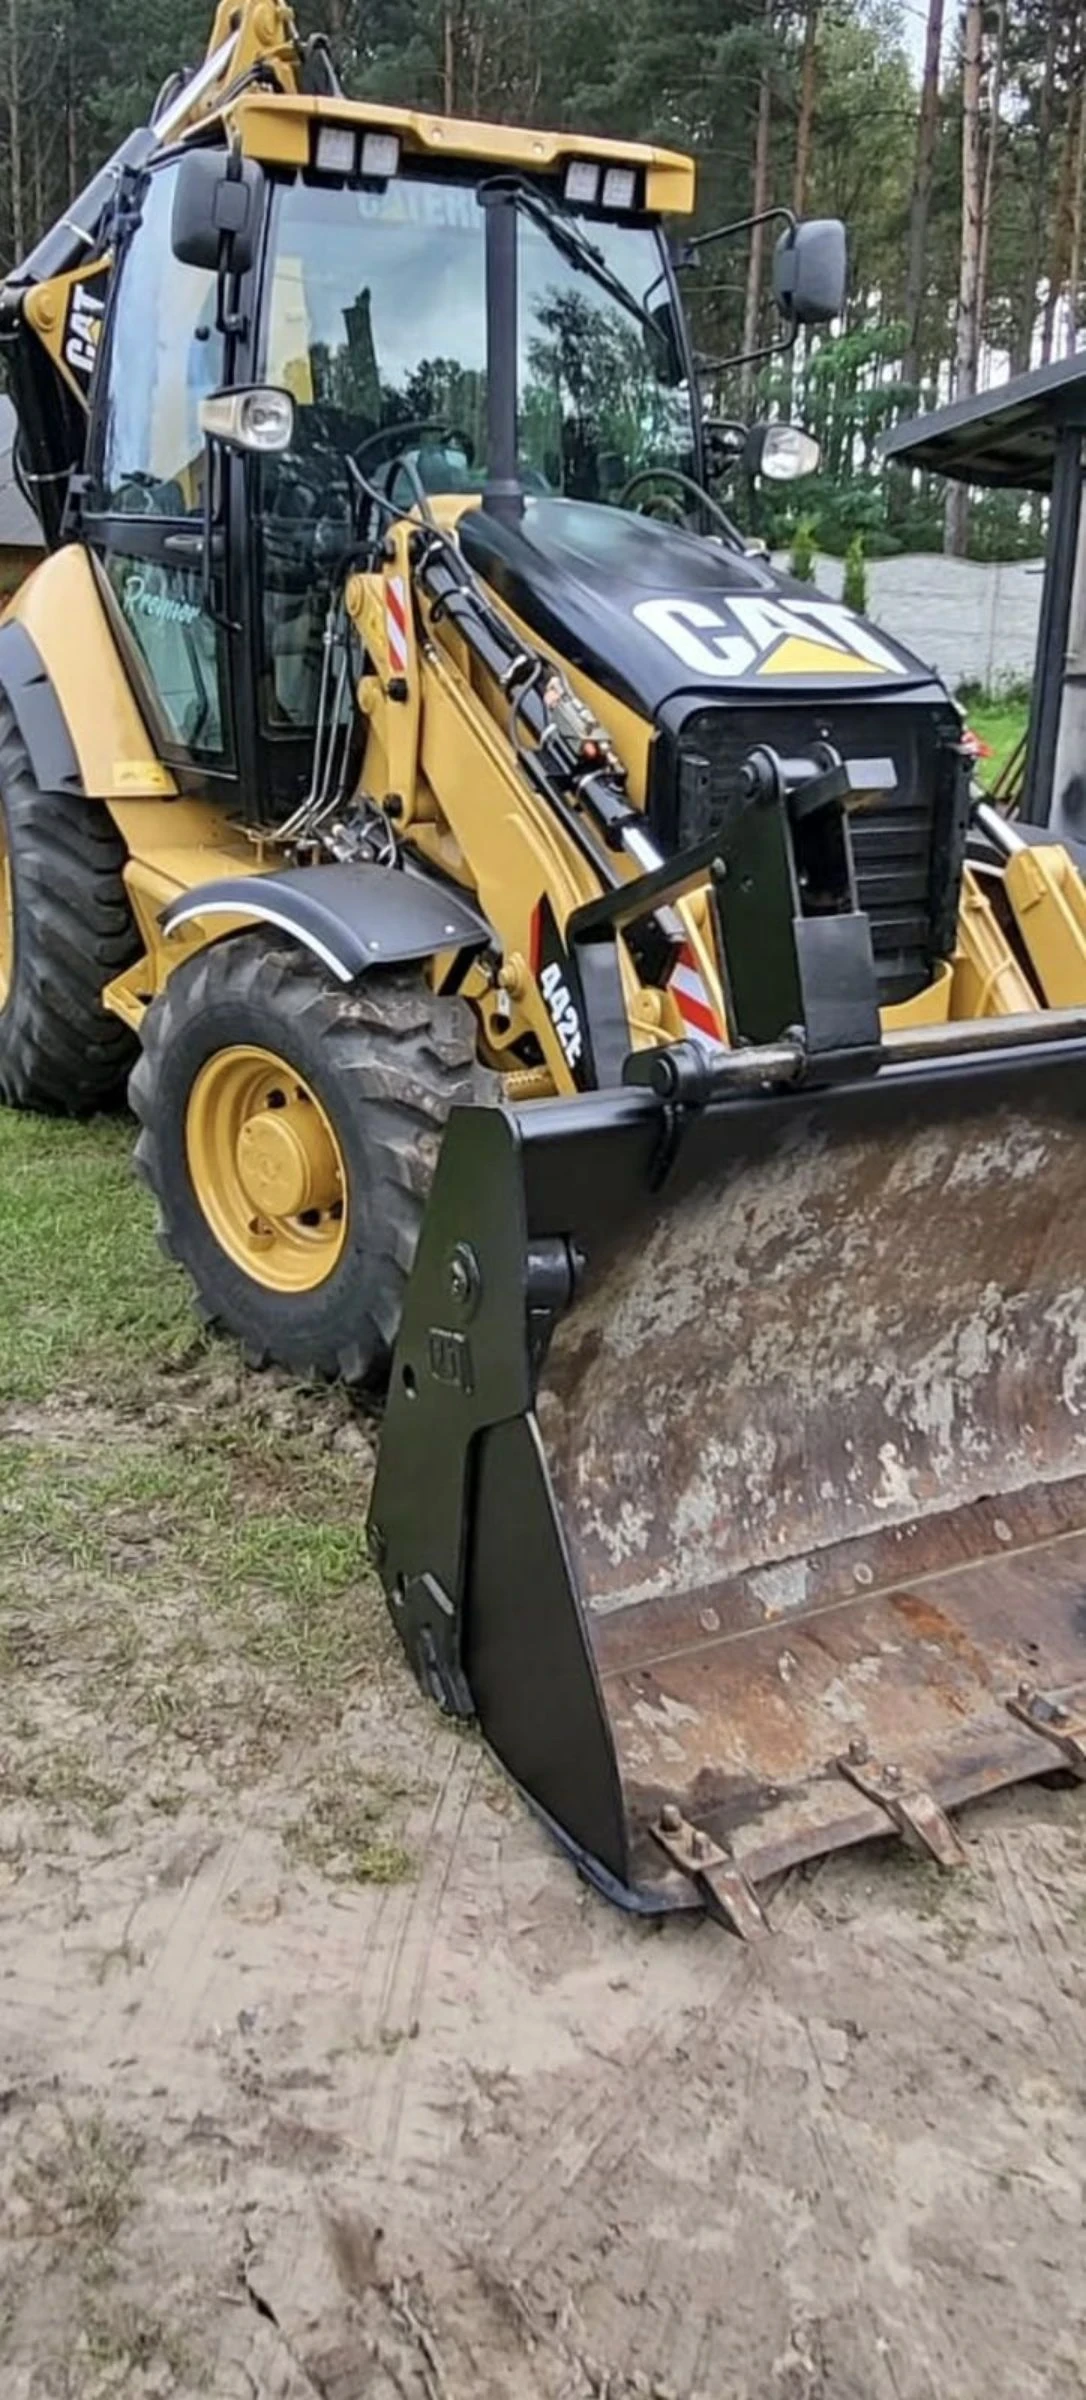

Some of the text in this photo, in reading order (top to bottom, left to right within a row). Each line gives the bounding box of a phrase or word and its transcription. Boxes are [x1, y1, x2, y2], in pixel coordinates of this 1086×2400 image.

[65, 283, 105, 372] CAT
[632, 597, 909, 677] CAT
[541, 962, 582, 1069] 442E
